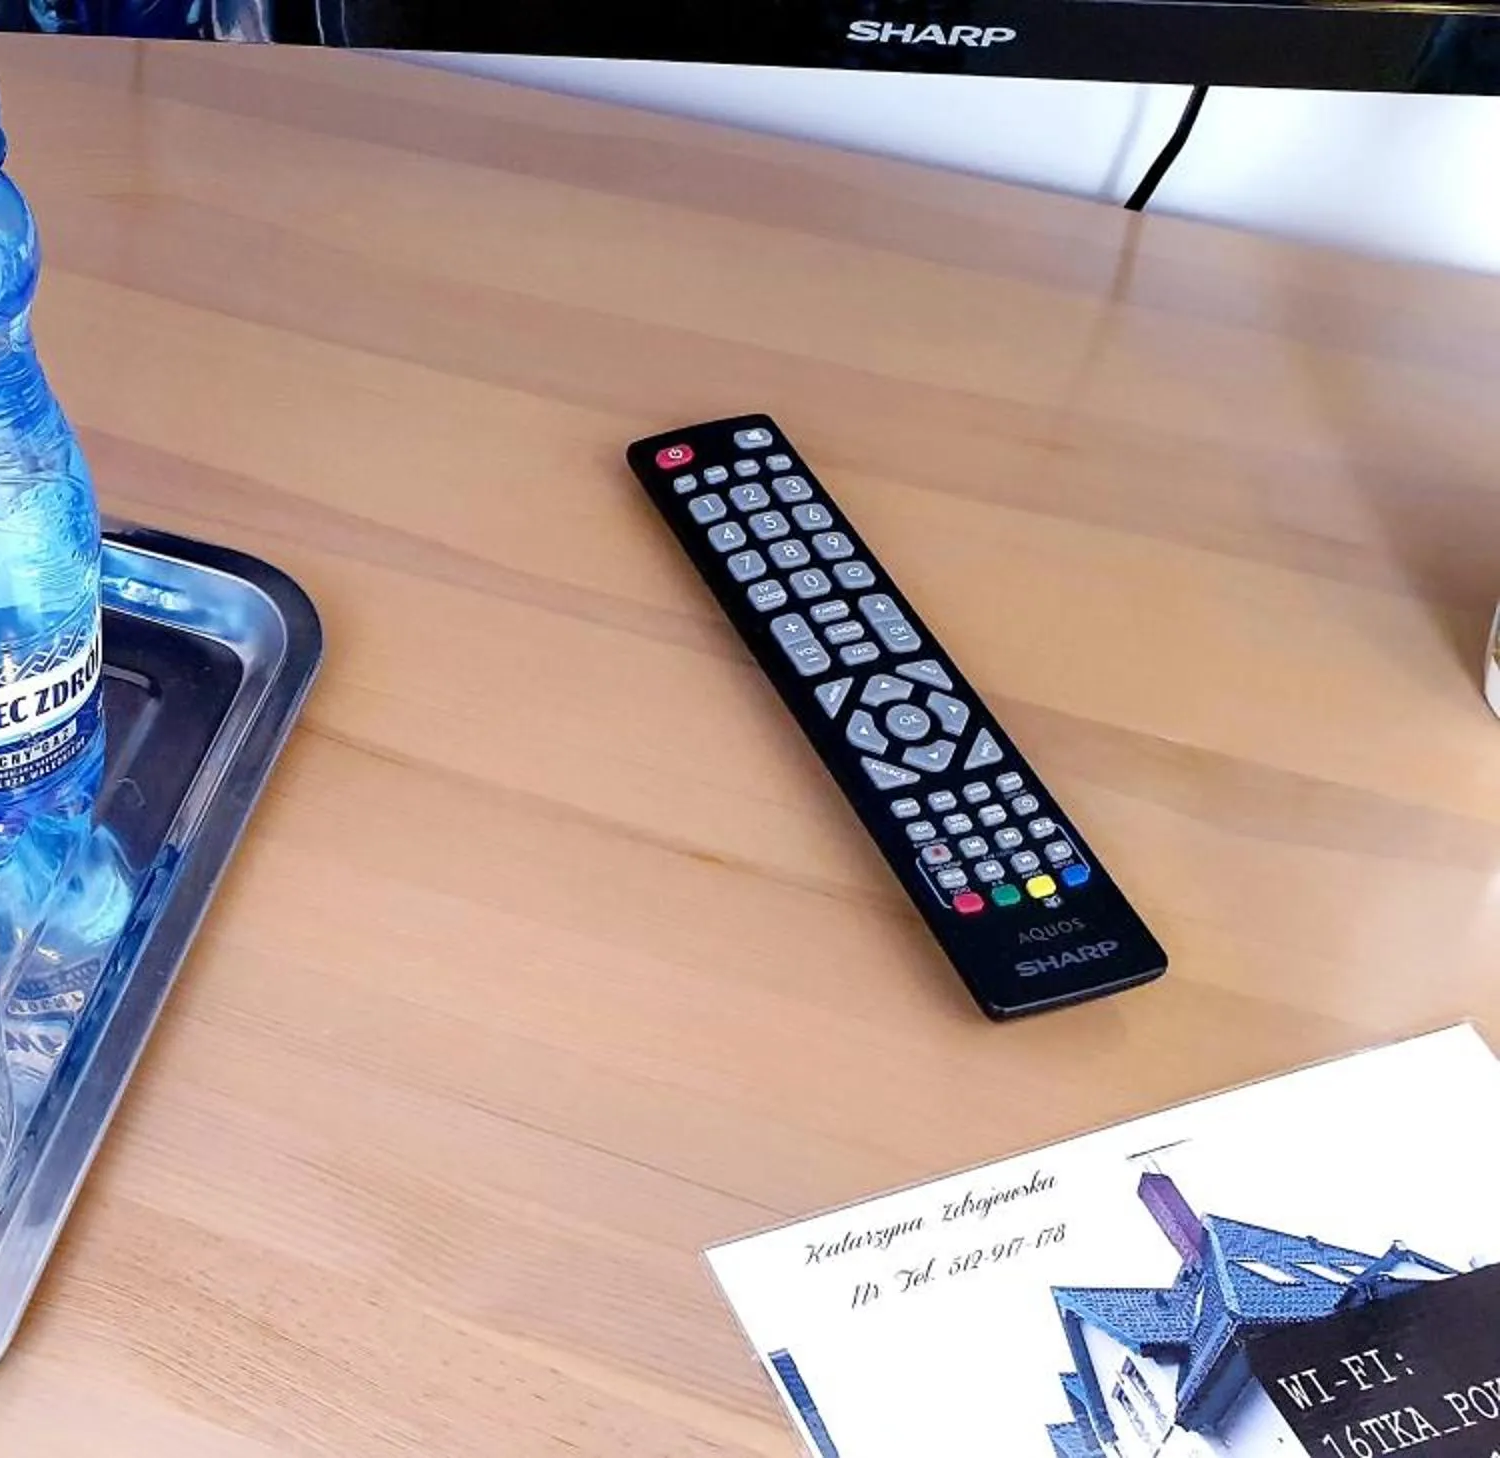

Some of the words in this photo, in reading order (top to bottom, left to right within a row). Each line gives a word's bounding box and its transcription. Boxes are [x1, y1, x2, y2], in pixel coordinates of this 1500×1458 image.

[846, 20, 1017, 47] SHARP
[743, 488, 759, 502] 2
[786, 479, 800, 494] 3
[723, 527, 735, 540] 4
[763, 515, 777, 529] 5
[809, 509, 821, 521] 6
[783, 545, 799, 559] 8
[827, 537, 839, 550] 9
[804, 574, 819, 589] 0
[41, 727, 70, 753] GAZ
[1018, 918, 1085, 944] AQUOS
[1015, 941, 1119, 977] SHARP
[805, 1217, 924, 1265] Katarzyna
[942, 1169, 1058, 1222] Zdrojewska
[948, 1223, 1068, 1275] 512-917-178
[1276, 1349, 1414, 1410] WI-FI:
